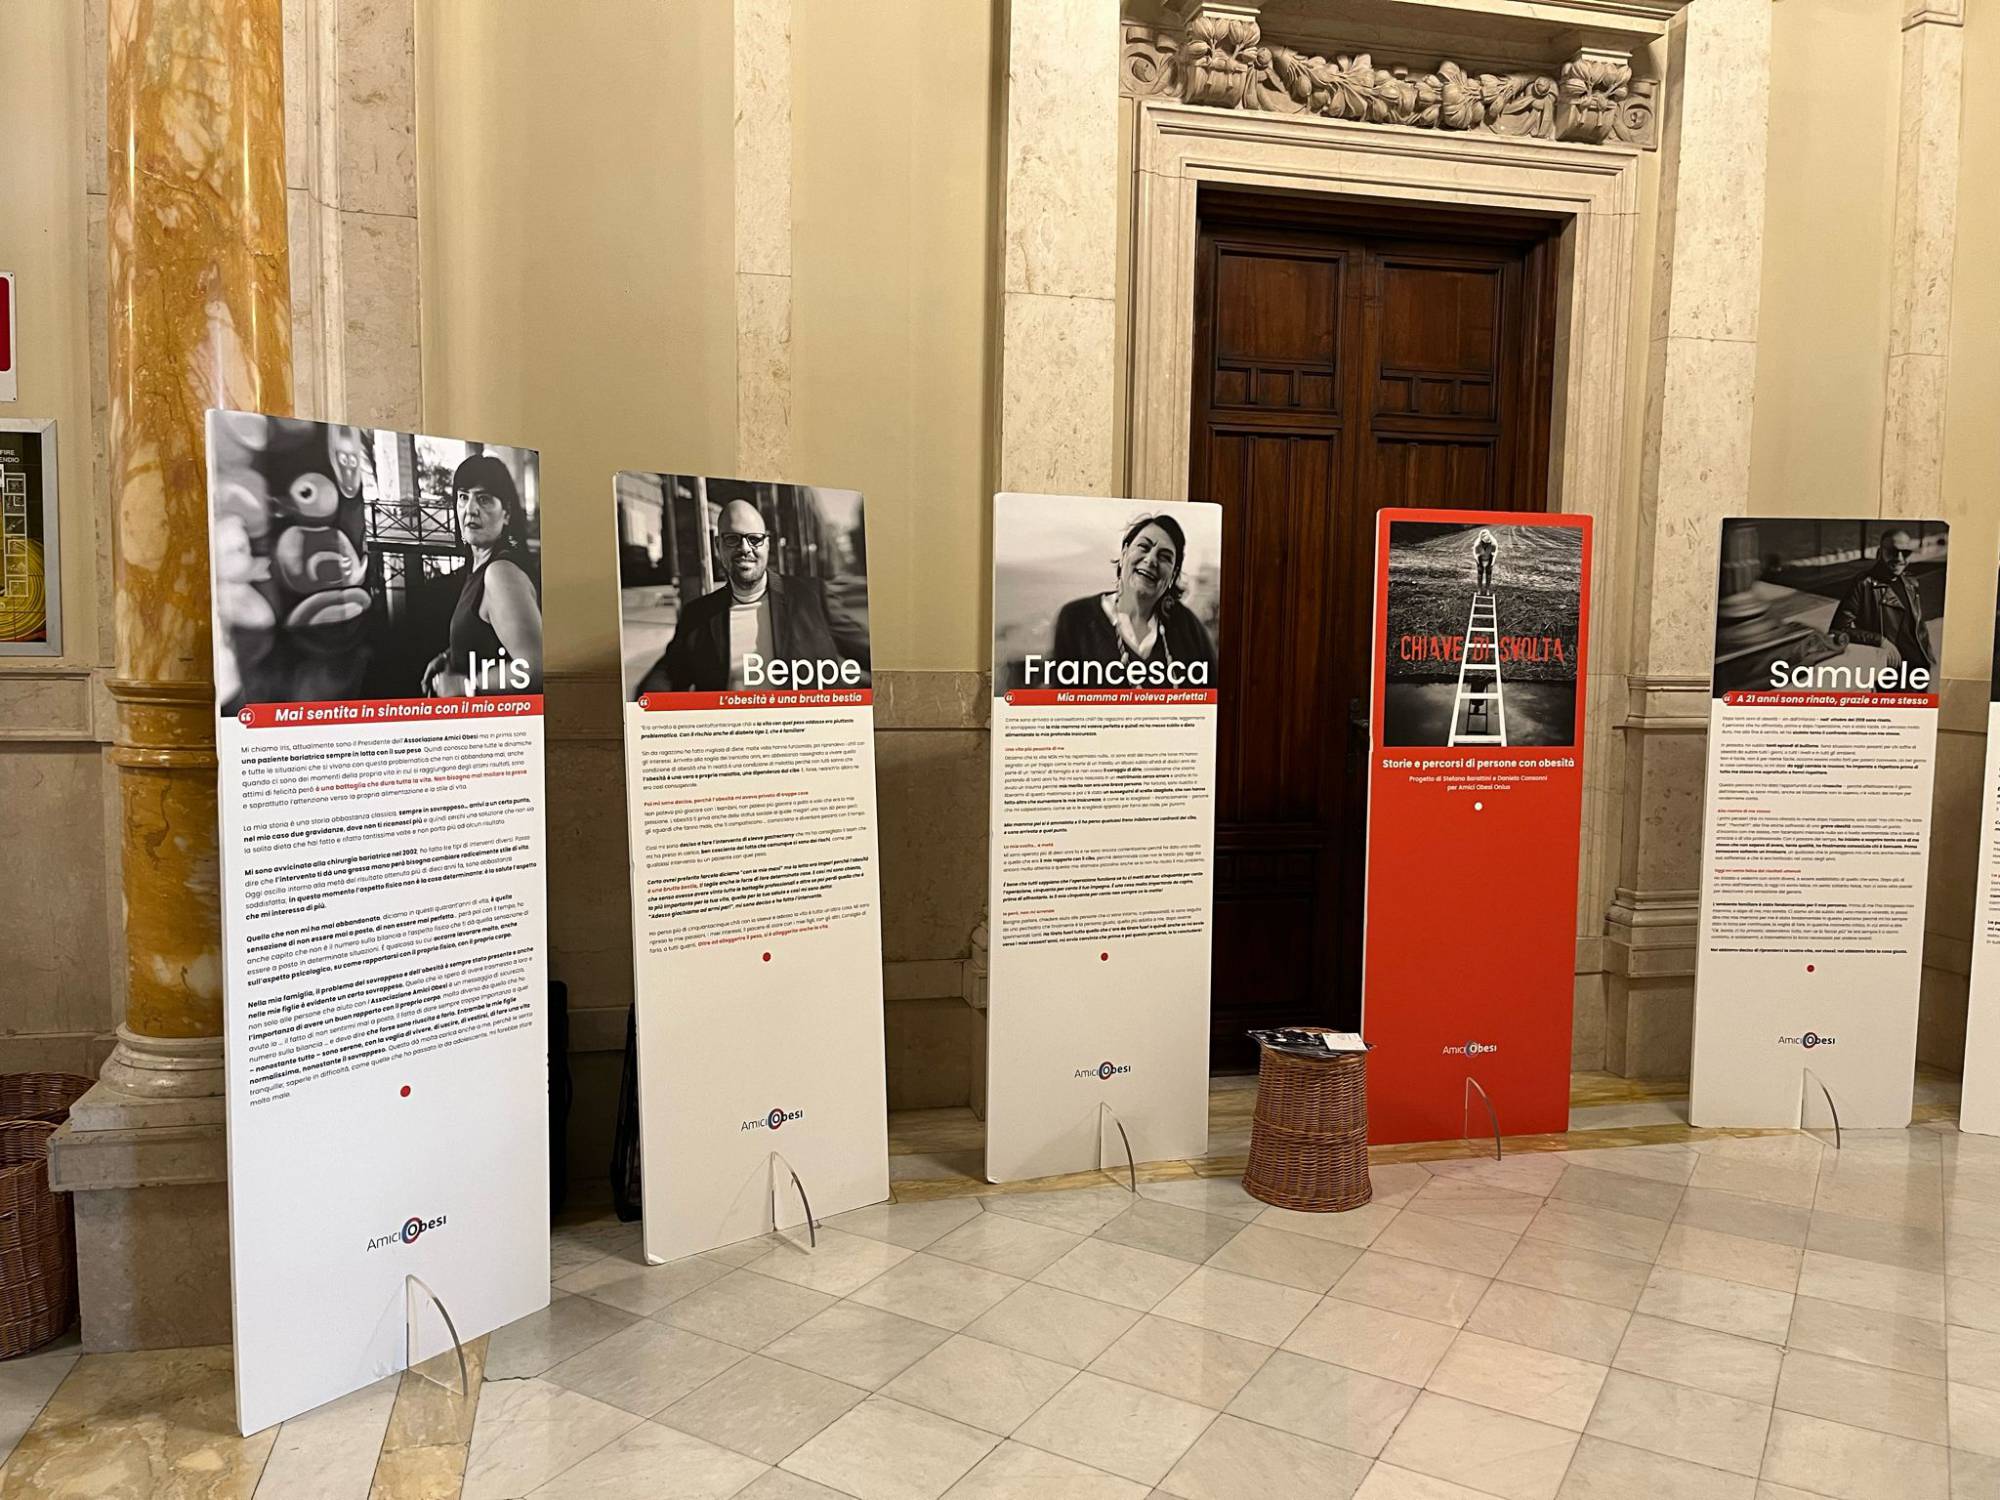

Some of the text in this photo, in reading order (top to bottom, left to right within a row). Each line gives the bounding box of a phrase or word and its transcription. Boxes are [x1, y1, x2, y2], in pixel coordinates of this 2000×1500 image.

[1401, 635, 1566, 663] CHIAVE DI SVOLTA
[469, 647, 530, 690] Iris
[743, 653, 861, 690] Beppe
[1025, 655, 1209, 685] Francesca
[1770, 660, 1930, 690] Samuele
[719, 692, 862, 705] L'obesità è una brutta bestia
[1057, 693, 1207, 703] Mia mamma mi voleva perfetta!
[1737, 695, 1743, 703] A
[1745, 695, 1755, 703] 21
[1757, 694, 1779, 703] anni
[1806, 694, 1837, 705] rinato,
[1840, 695, 1869, 706] grazie
[1897, 696, 1929, 705] stesso
[275, 701, 531, 721] Mai sentita in sintonia con il mio corpo
[1382, 758, 1412, 768] Storie
[1422, 758, 1463, 771] percorsi
[1465, 758, 1475, 768] di
[1477, 760, 1517, 771] persone
[1538, 758, 1575, 767] obesità
